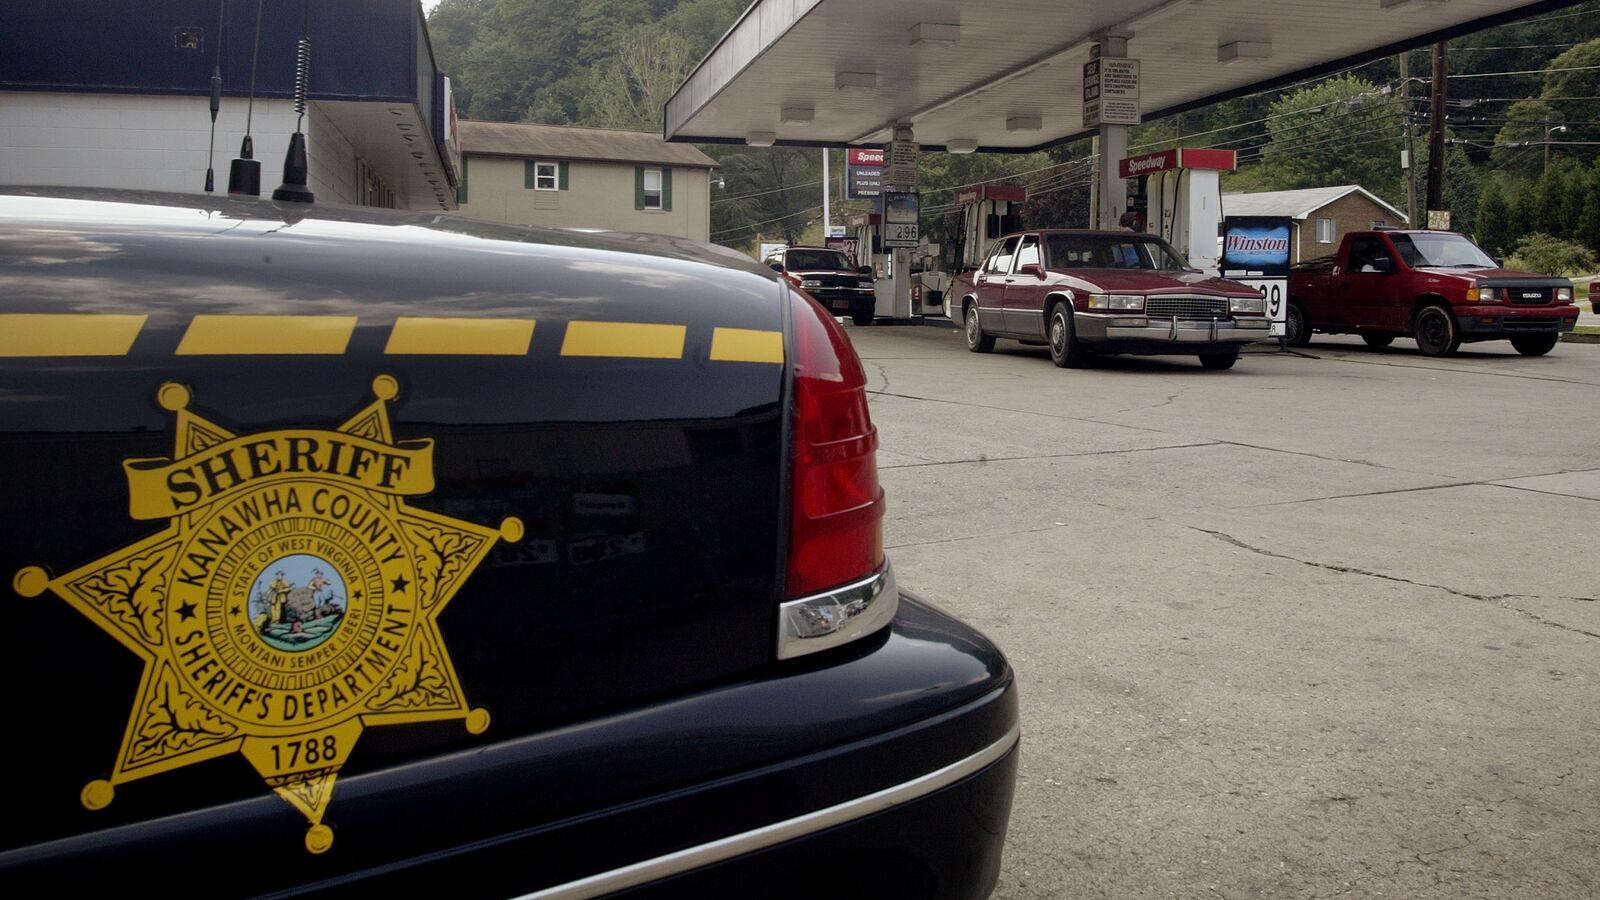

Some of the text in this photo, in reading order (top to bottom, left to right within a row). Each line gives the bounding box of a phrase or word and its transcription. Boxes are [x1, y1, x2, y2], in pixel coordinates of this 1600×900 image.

[1128, 155, 1166, 174] Speedway
[1226, 235, 1287, 251] Winston
[166, 437, 412, 510] SHERIFF
[177, 487, 405, 587] KANAWHA COUNTY
[232, 539, 359, 597] STATE OF WEST VIRGINIA
[175, 604, 412, 721] SHERIFF'S DEPARTMENT
[233, 608, 362, 668] MONTANI SEMPER LIBERI
[271, 735, 337, 771] 1788
